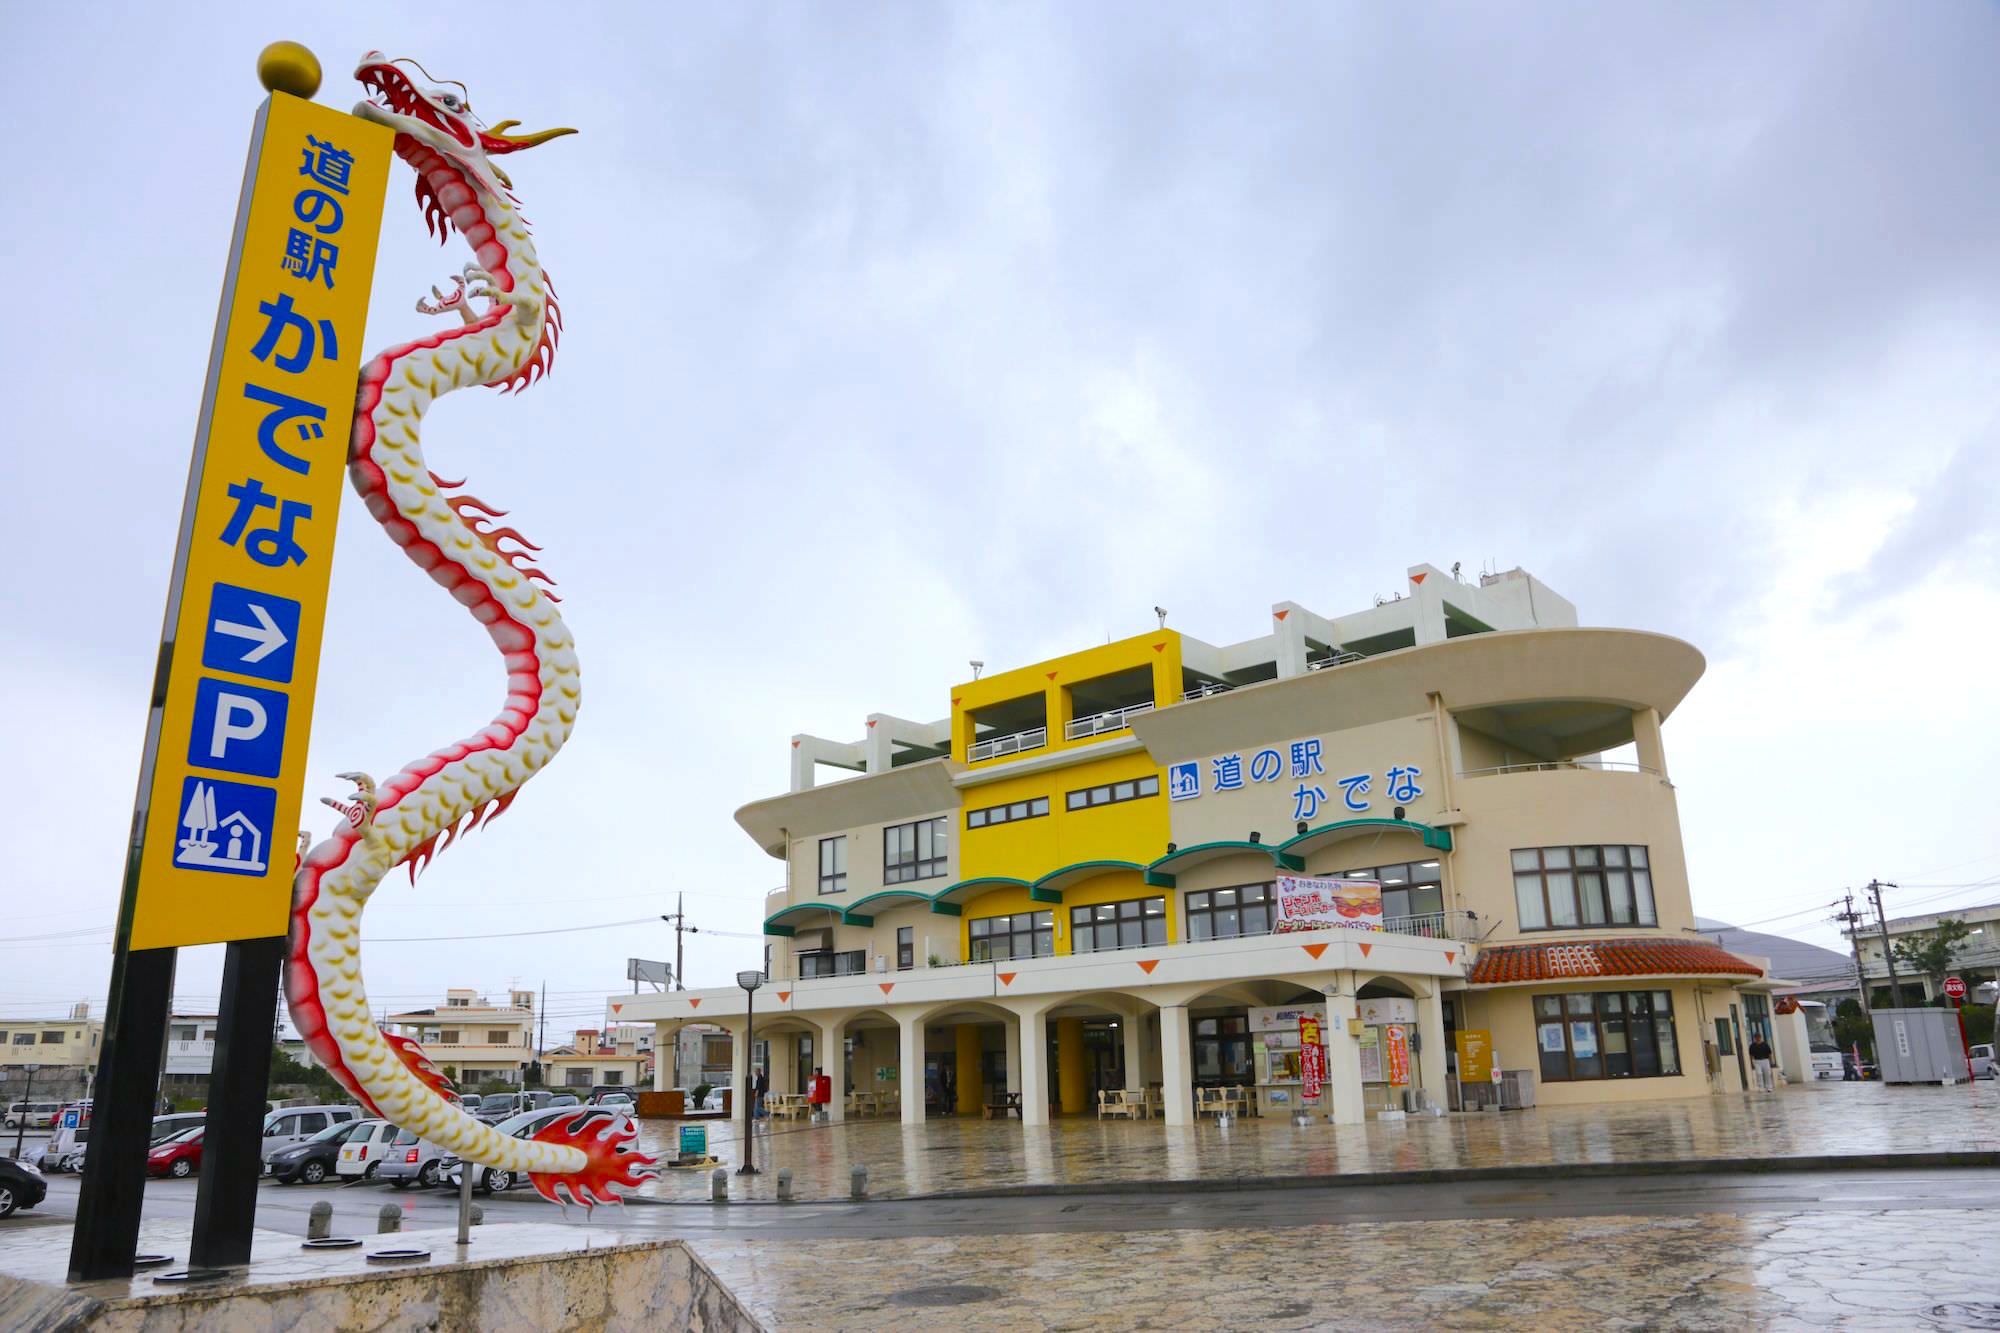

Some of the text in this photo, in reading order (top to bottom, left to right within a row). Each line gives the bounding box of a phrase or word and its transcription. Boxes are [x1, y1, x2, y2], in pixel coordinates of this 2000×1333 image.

[219, 134, 356, 568] 道の駅 かでな
[210, 691, 268, 759] P
[1211, 738, 1325, 792] 道の駅
[1291, 766, 1424, 821] かでな
[68, 1115, 76, 1126] P
